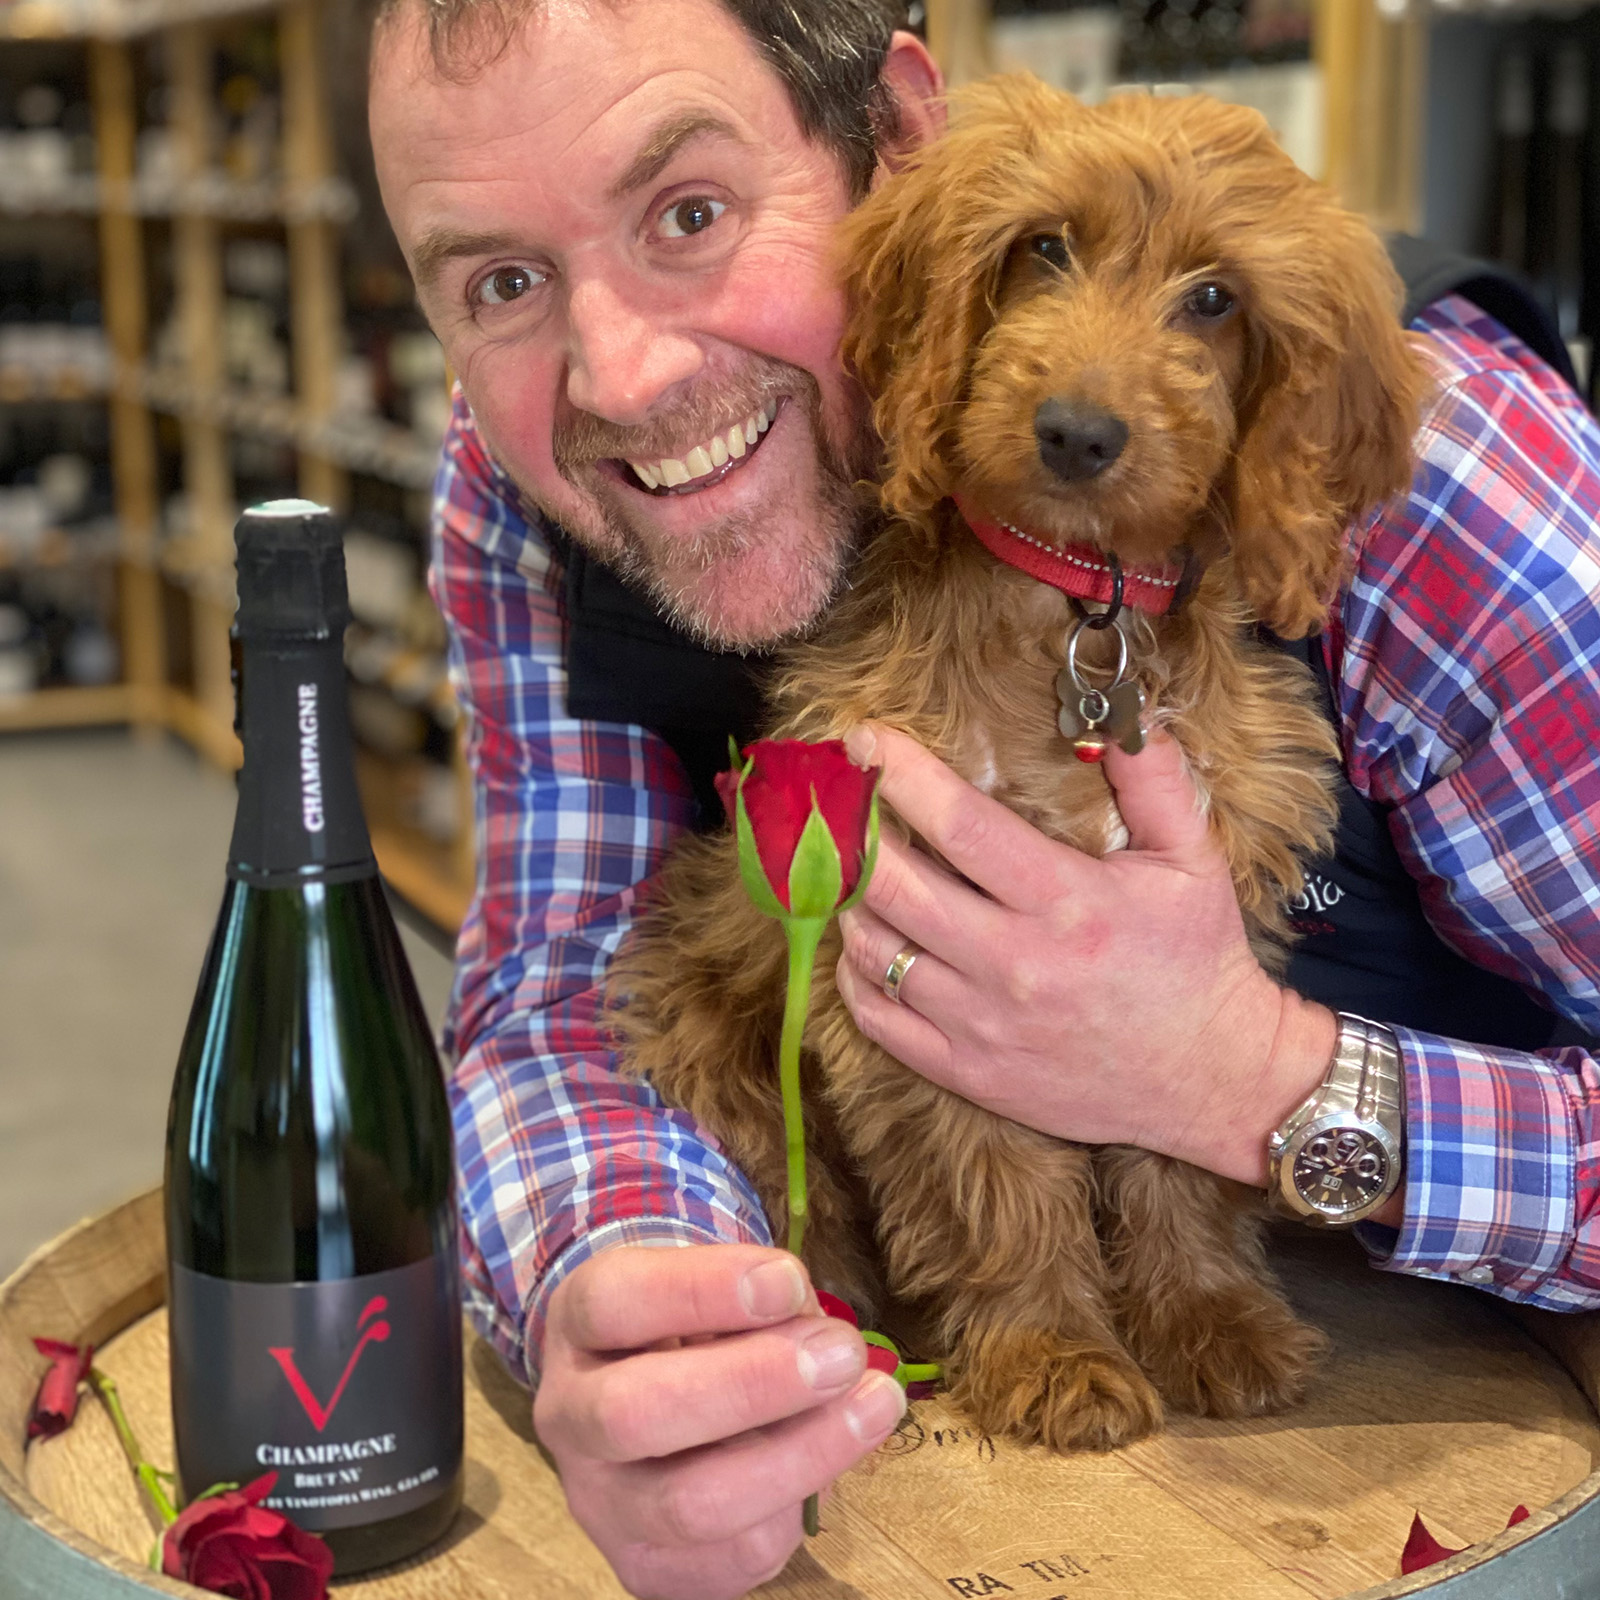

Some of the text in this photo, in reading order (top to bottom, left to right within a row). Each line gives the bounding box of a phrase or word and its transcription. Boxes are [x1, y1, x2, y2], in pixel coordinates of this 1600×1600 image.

[298, 683, 325, 832] CHAMPAGNE
[256, 1432, 397, 1465] CHAMPAGNE
[947, 1572, 1014, 1599] RA
